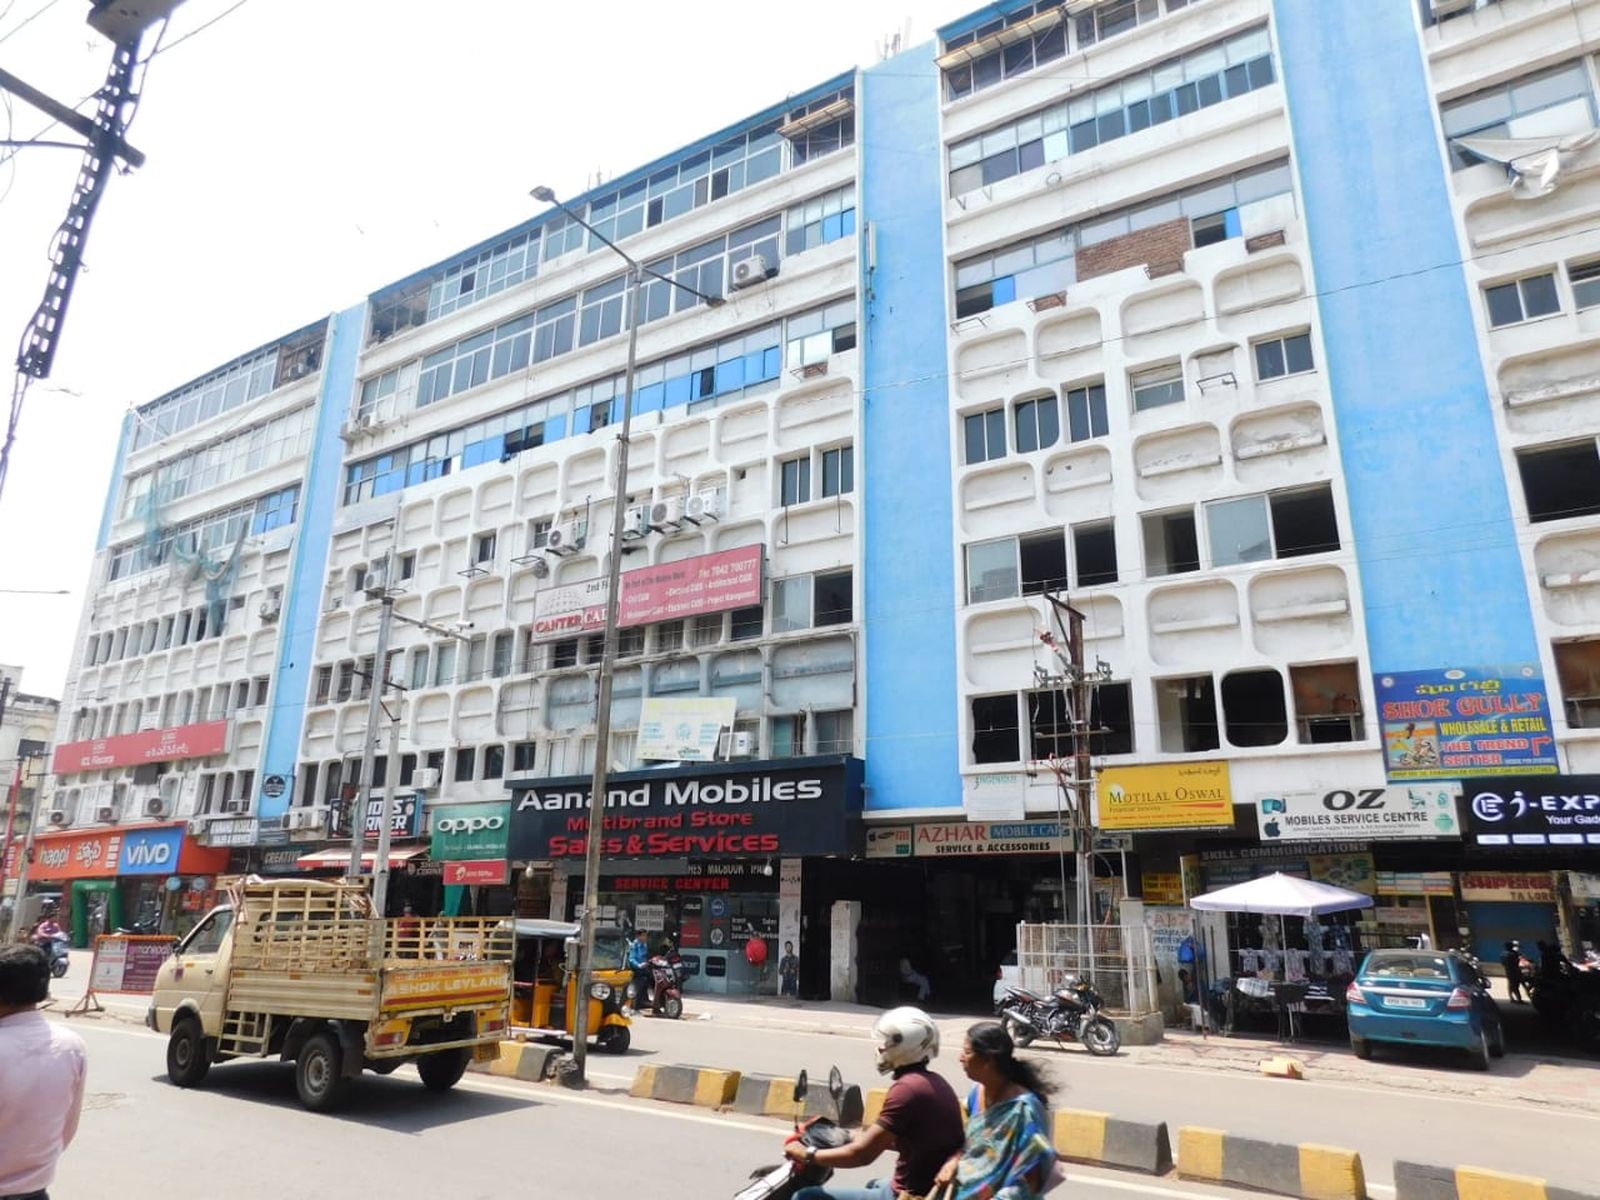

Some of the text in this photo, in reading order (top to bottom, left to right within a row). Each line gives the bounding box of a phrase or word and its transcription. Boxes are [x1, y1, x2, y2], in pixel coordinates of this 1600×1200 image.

[1383, 693, 1544, 721] SHOE GULLY
[1440, 717, 1547, 735] WHOLESALE & RETAIL
[1441, 738, 1529, 752] THE TREND
[664, 776, 823, 805] Mobiles
[1322, 788, 1387, 811] OZ
[438, 816, 504, 835] oppo
[690, 810, 752, 828] Store
[1285, 811, 1428, 826] MOBILES SERVICE CENTRE
[1545, 815, 1572, 825] Your
[626, 834, 642, 855] &
[646, 830, 780, 854] Services
[917, 825, 988, 843] AZHAR
[992, 823, 1038, 838] MOBILE
[127, 838, 171, 865] vivo
[935, 841, 1050, 854] SERVICE & ACCESSORIES
[1202, 842, 1369, 861] SKILL COMMUNICATIONS
[750, 864, 765, 875] IPA
[614, 877, 730, 891] SERVICE CENTER
[386, 976, 508, 996] ASHOK LEYLAND
